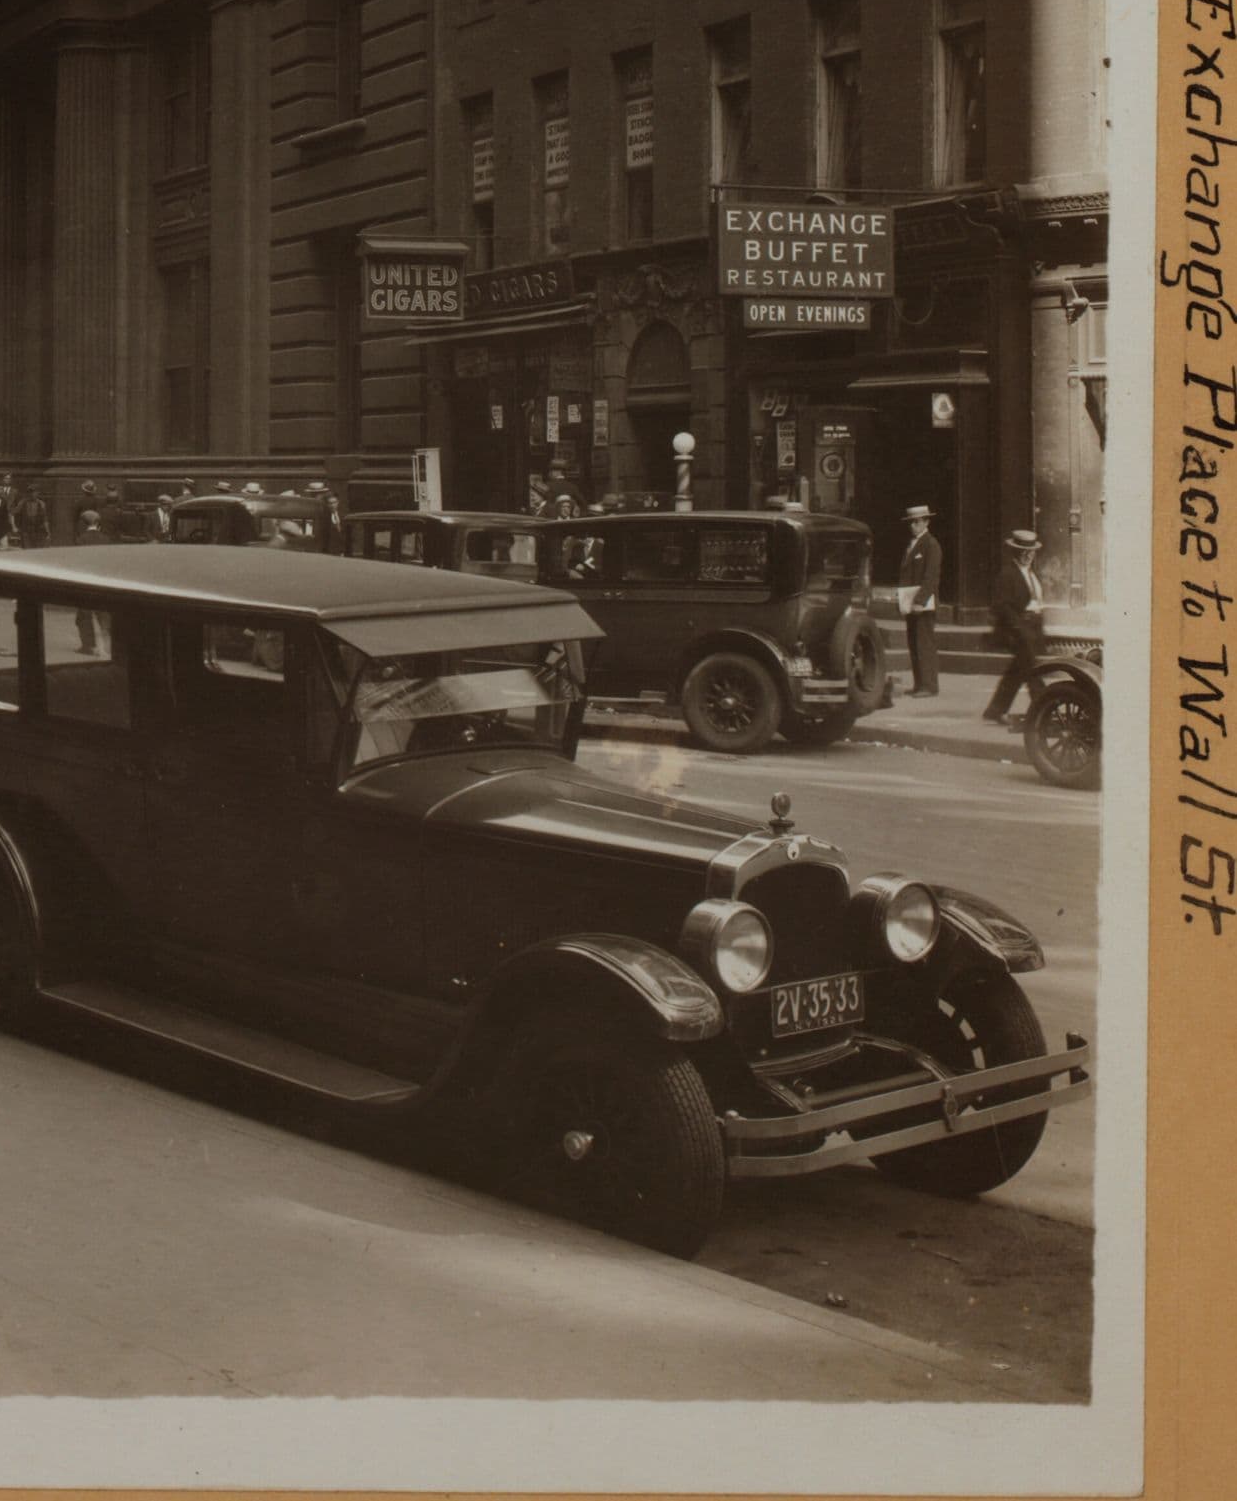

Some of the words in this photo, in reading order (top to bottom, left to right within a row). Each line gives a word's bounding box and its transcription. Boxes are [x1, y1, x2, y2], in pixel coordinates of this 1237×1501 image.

[725, 209, 887, 236] EXCHANGE
[744, 239, 870, 265] BUFFET
[370, 264, 460, 288] UNITED
[490, 270, 559, 303] CIGARS
[726, 268, 887, 291] RESTAURANT
[370, 288, 460, 313] CIGARS
[749, 304, 787, 323] OPEN
[796, 304, 866, 324] EVENINGS
[1179, 363, 1237, 562] Place
[1182, 580, 1234, 622] to
[1178, 644, 1237, 820] Wall
[1181, 834, 1236, 936] St.
